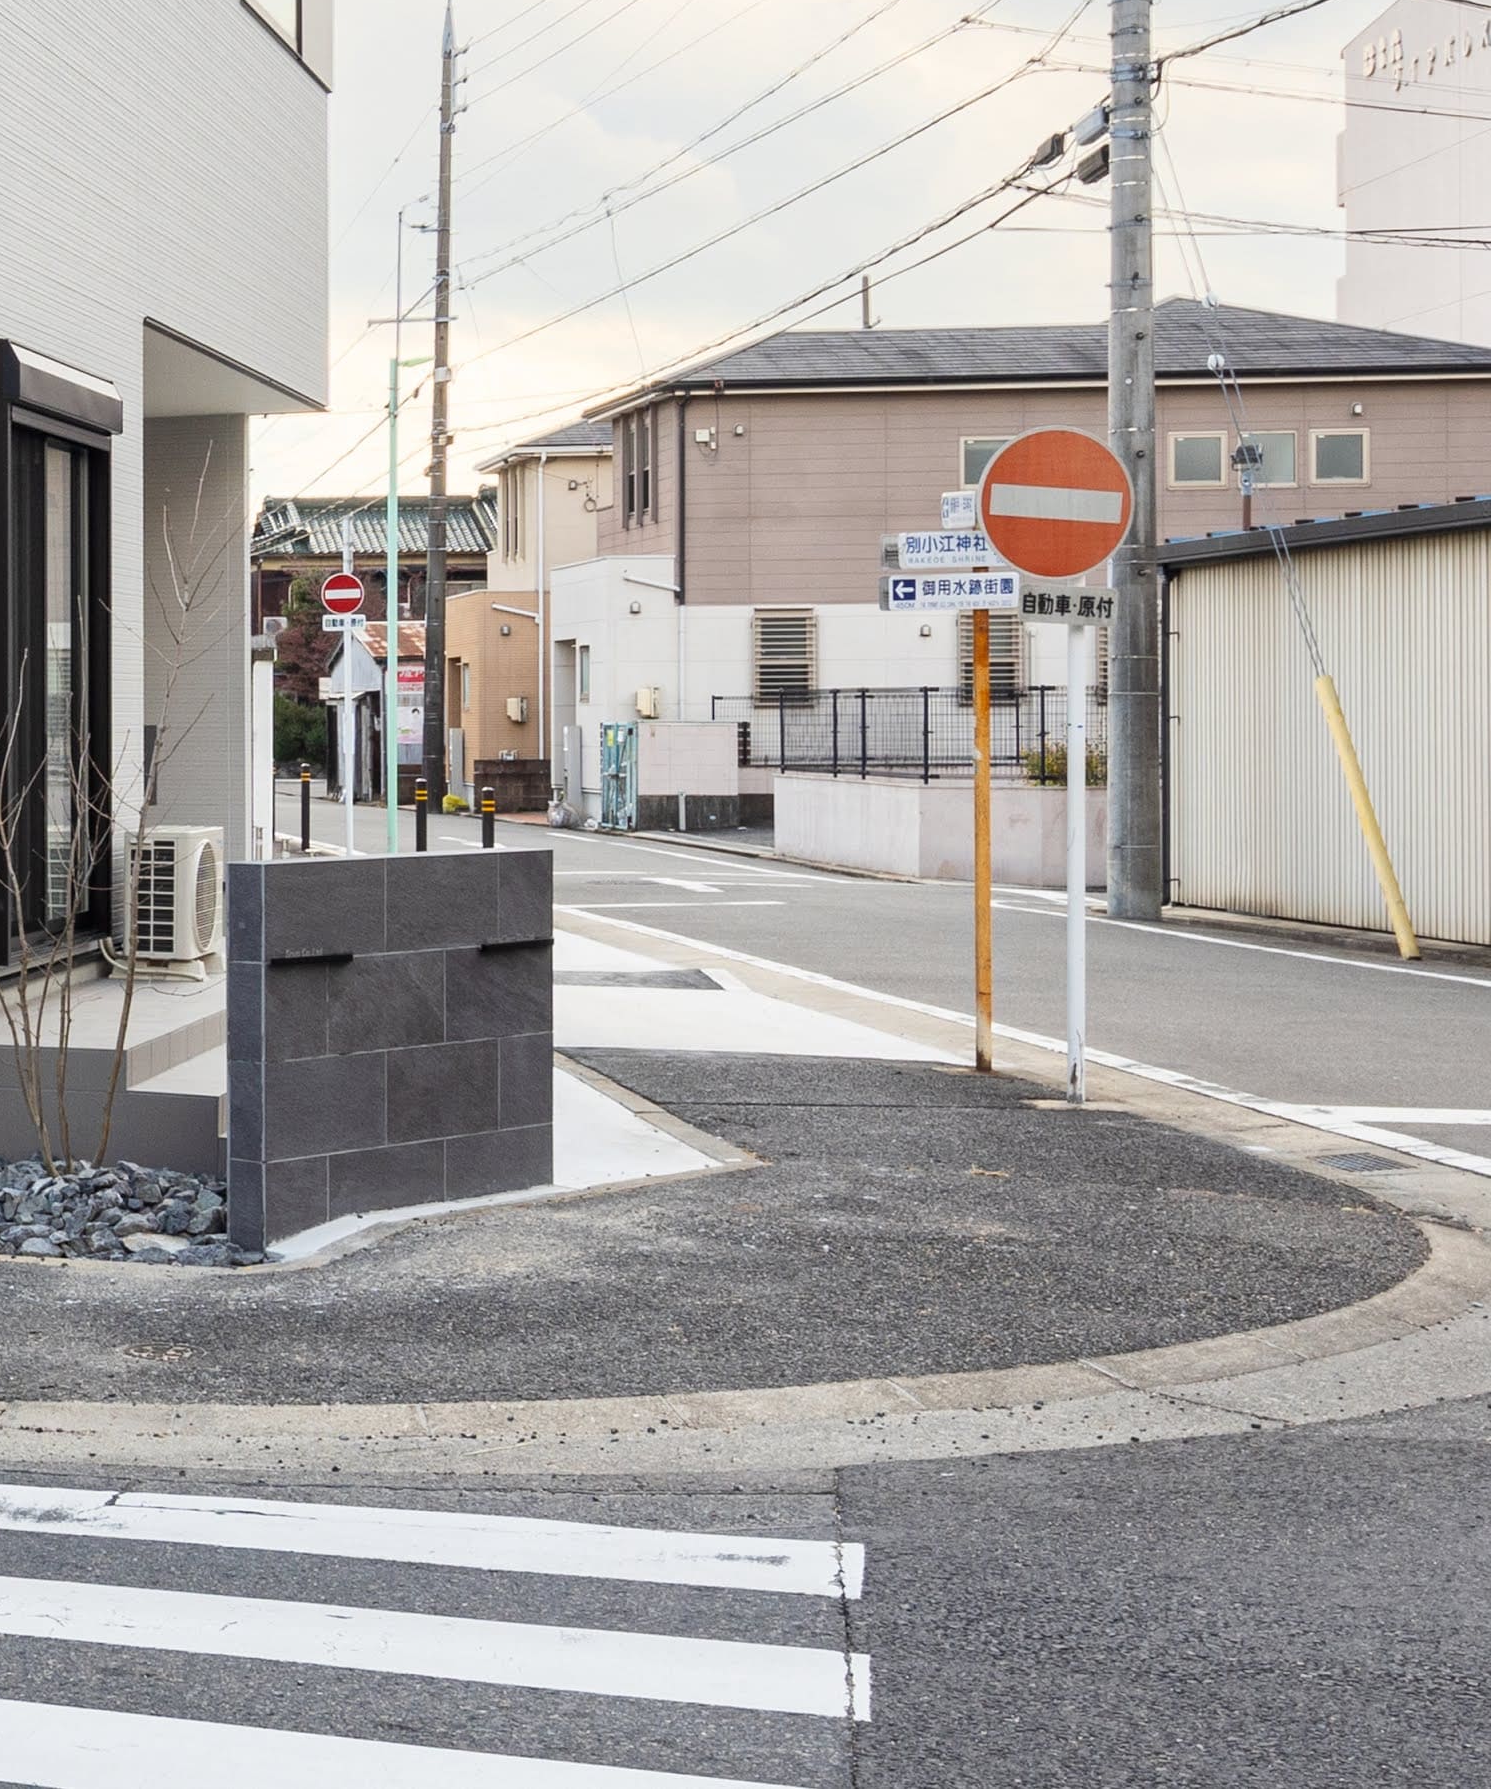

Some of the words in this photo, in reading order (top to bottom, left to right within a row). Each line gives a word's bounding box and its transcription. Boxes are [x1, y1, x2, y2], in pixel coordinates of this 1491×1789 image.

[906, 535, 988, 554] 別小江神社
[922, 578, 1014, 596] 御用水跡街園
